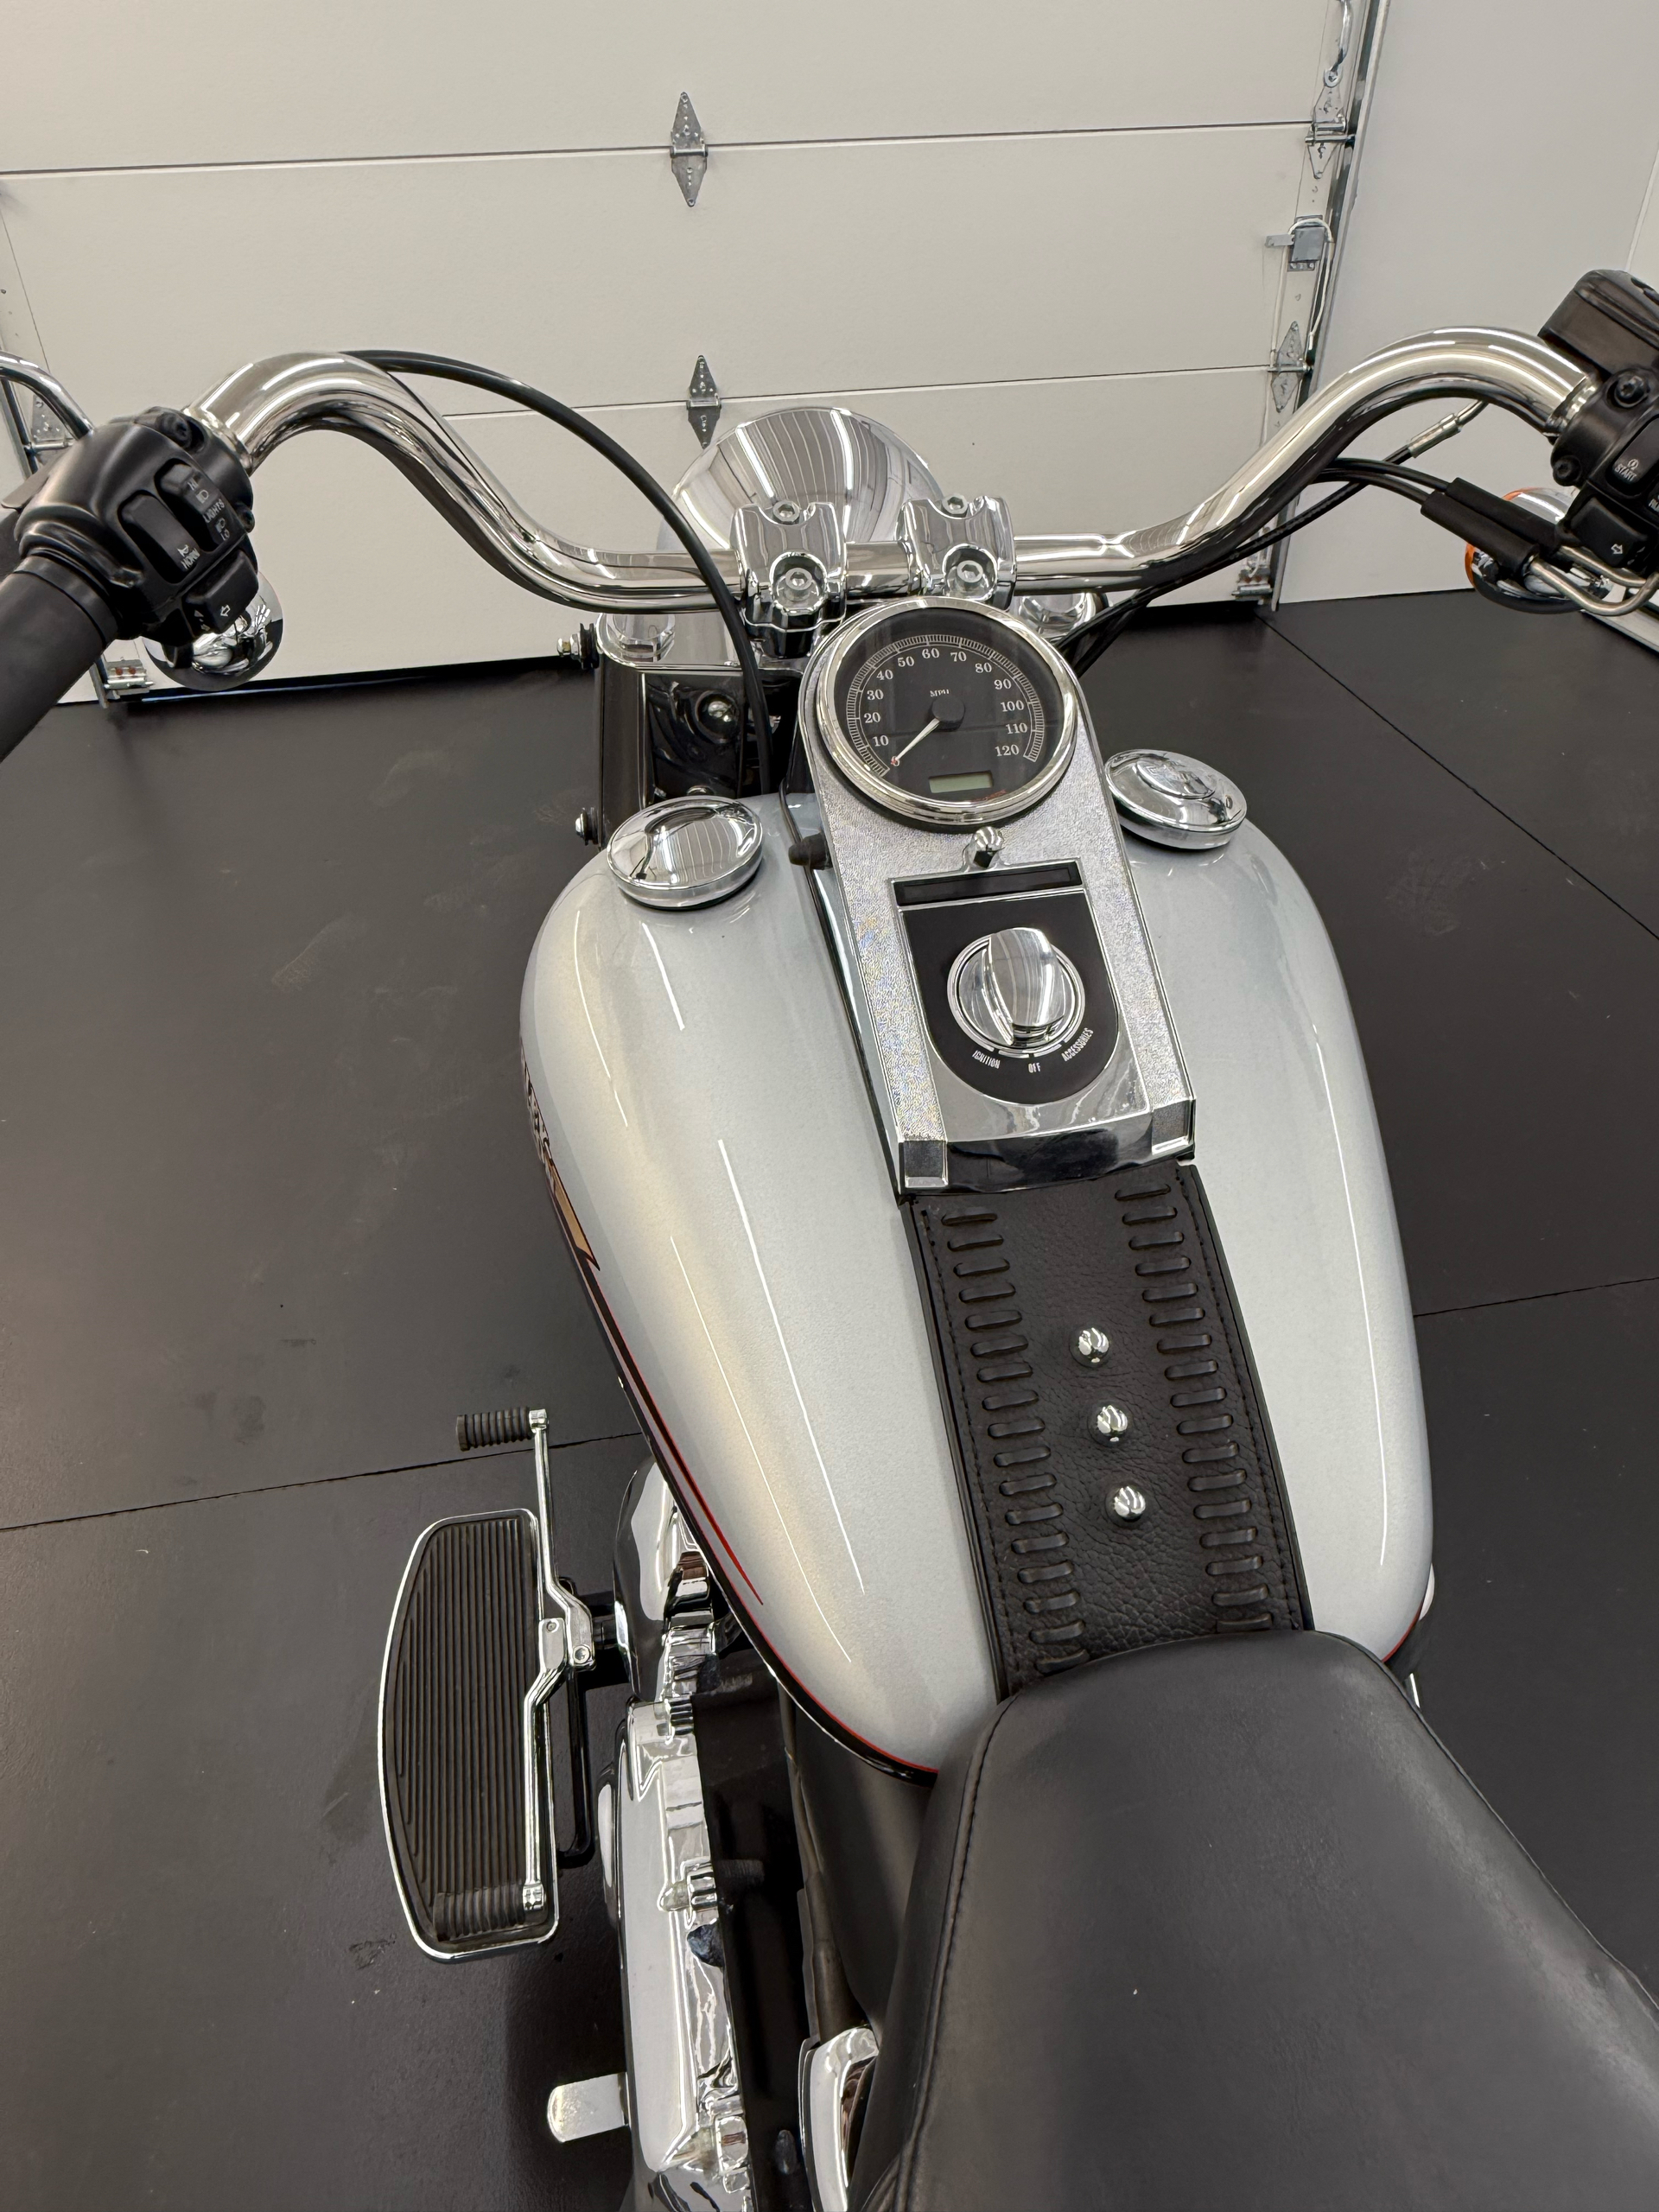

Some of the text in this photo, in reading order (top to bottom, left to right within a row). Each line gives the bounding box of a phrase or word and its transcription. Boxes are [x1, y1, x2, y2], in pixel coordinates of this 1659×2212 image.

[1614, 464, 1637, 481] START
[202, 499, 225, 524] LIGHTS
[181, 548, 200, 569] HORN
[922, 648, 940, 659] 60
[950, 652, 967, 663] 70
[897, 656, 915, 667] 50
[975, 662, 993, 674] 80
[876, 670, 893, 681] 40
[994, 679, 1012, 690] 90
[867, 690, 884, 701] 30
[1001, 700, 1025, 712] 100
[864, 713, 881, 724] 20
[1005, 723, 1028, 734] 110
[872, 735, 889, 747] 10
[995, 745, 1020, 757] 120
[1062, 1027, 1093, 1062] ACCESSORIES
[971, 1050, 1001, 1069] IGNITION
[1028, 1063, 1041, 1073] OFF
